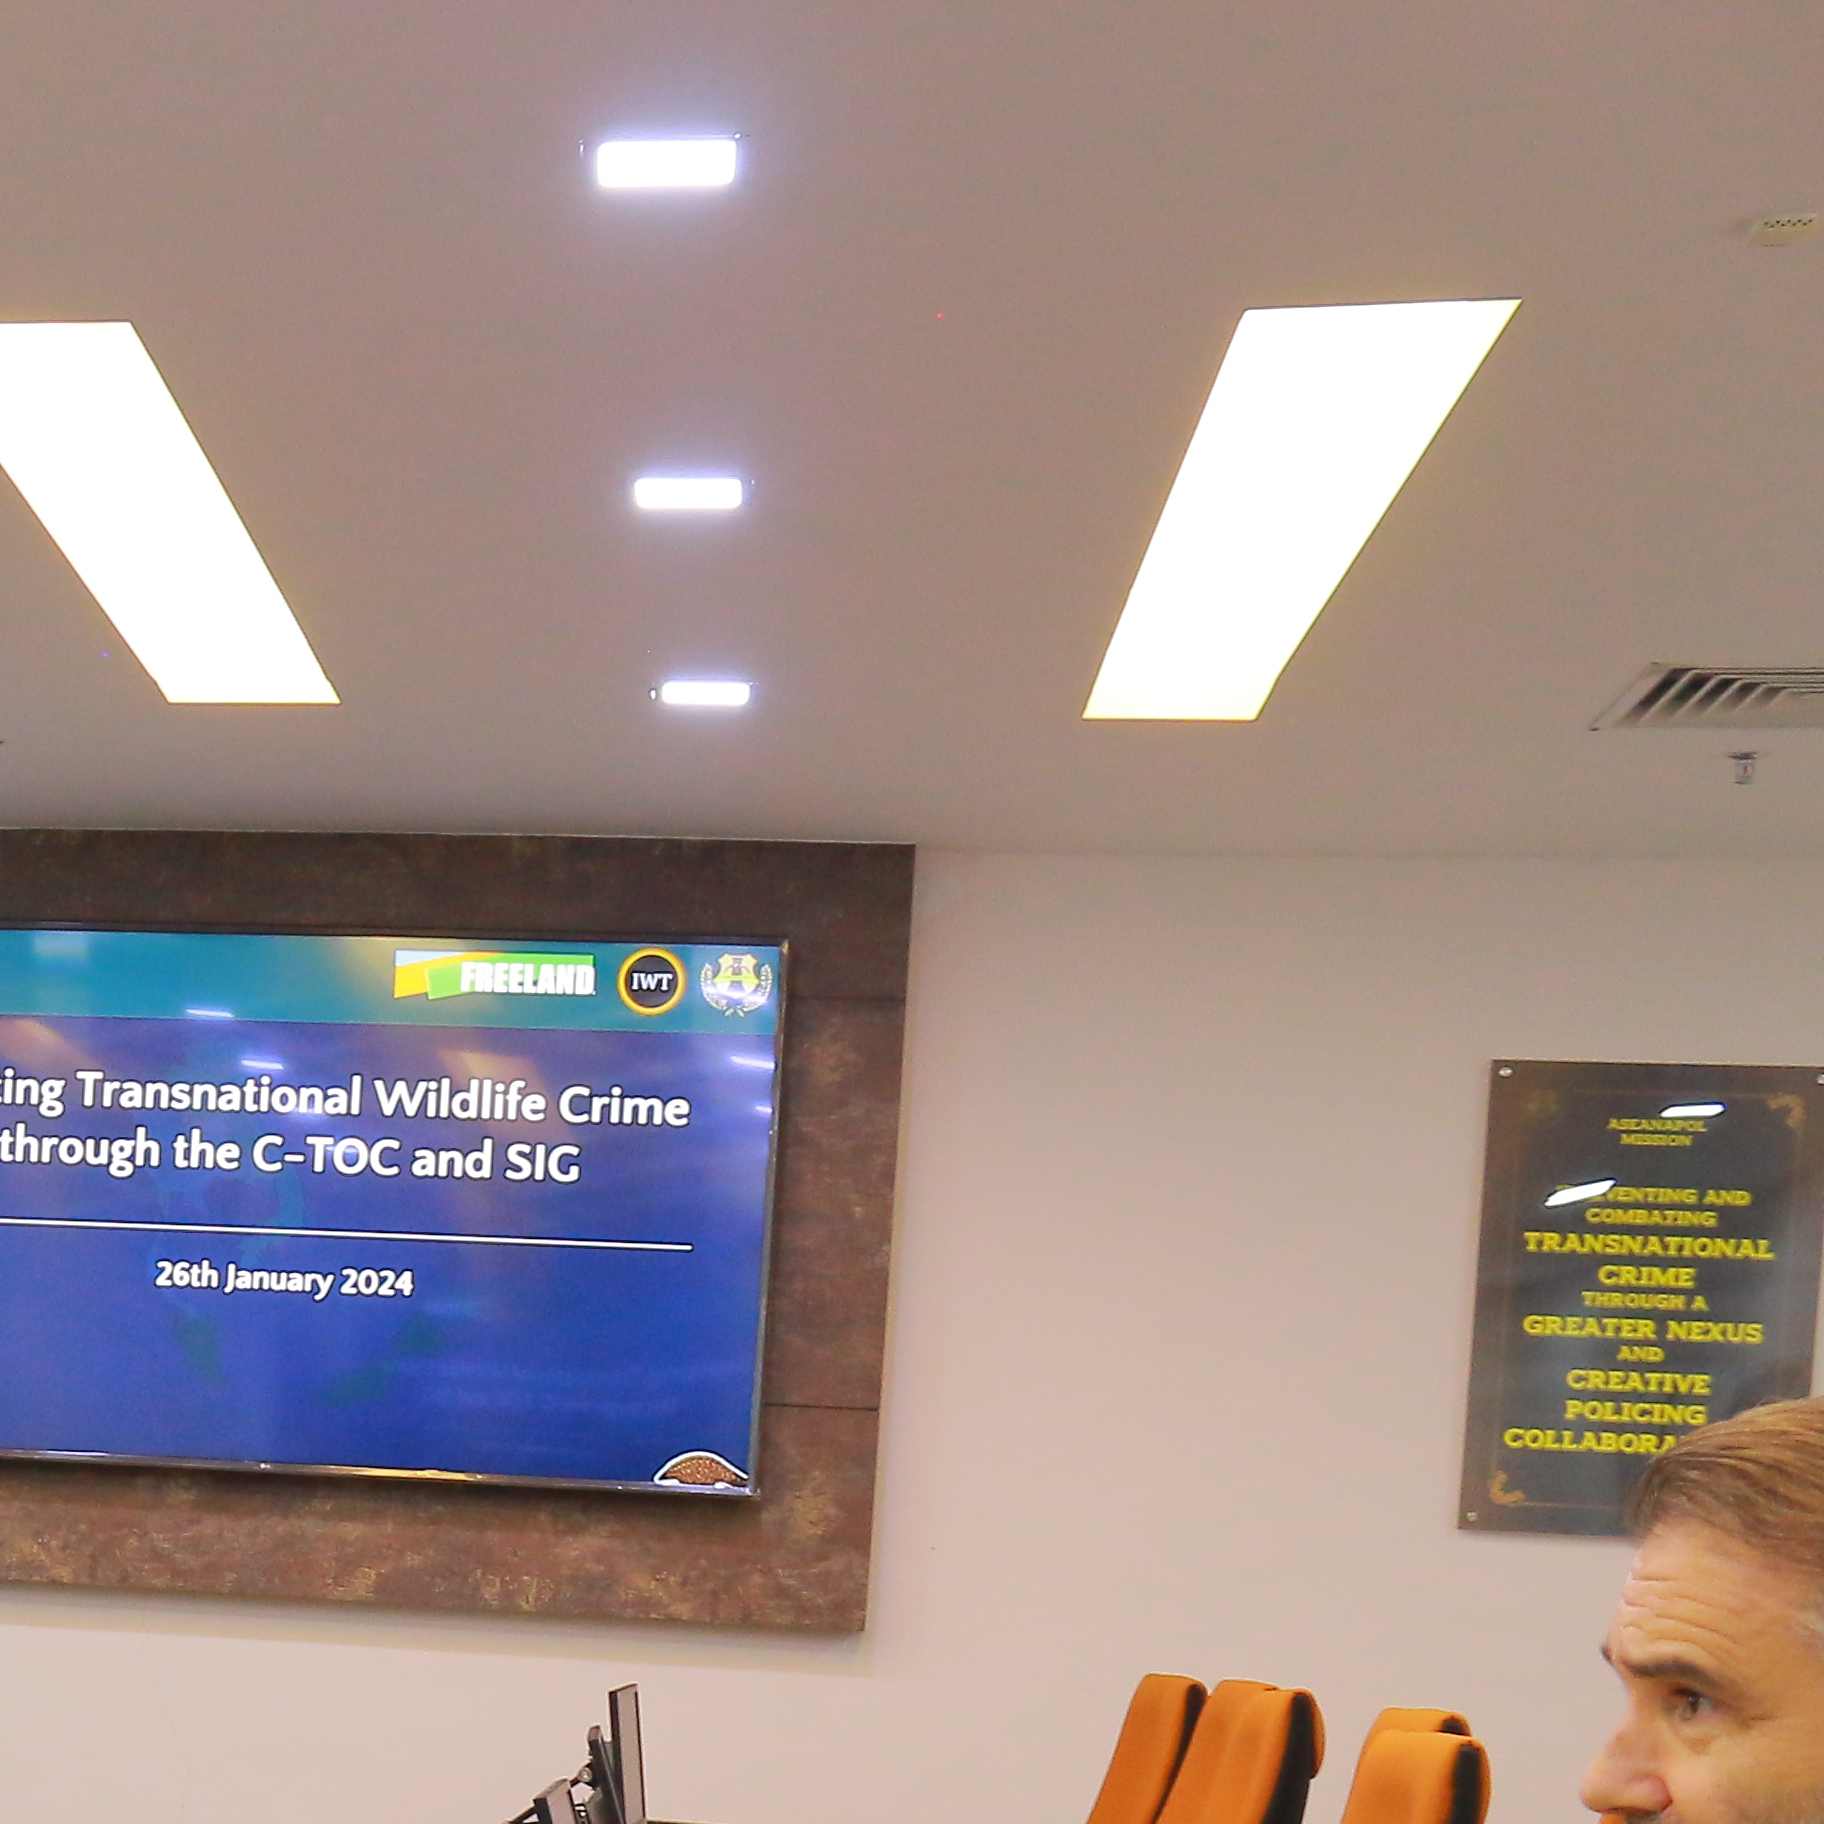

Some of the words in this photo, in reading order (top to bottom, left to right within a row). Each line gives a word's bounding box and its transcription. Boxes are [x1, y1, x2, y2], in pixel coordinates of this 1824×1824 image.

[630, 972, 673, 992] IWT
[78, 1070, 362, 1117] Transnational
[373, 1077, 547, 1123] Wildlife
[558, 1087, 691, 1128] Crime
[1606, 1117, 1708, 1132] ASEANAPOL
[1620, 1133, 1694, 1146] MISSION
[172, 1130, 240, 1172] the
[252, 1135, 400, 1177] C-TOC
[411, 1141, 494, 1181] and
[504, 1143, 582, 1184] SIG
[1555, 1184, 1699, 1205] VENTING
[1703, 1189, 1752, 1206] AND
[1585, 1207, 1718, 1227] COMBATING
[1524, 1231, 1776, 1260] TRANSNATIONAL
[156, 1260, 218, 1292] 26th
[225, 1263, 335, 1301] January
[339, 1268, 414, 1298] 2024
[1597, 1264, 1696, 1288] CRIME
[1581, 1290, 1686, 1311] THROUGH
[1691, 1295, 1710, 1312] A
[1522, 1313, 1657, 1339] GREATER
[1666, 1320, 1764, 1345] NEXUS
[1617, 1344, 1666, 1363] AND
[1565, 1369, 1712, 1394] CREATIVE
[1563, 1399, 1709, 1426] POLICING
[1503, 1427, 1678, 1454] COLLABORA
